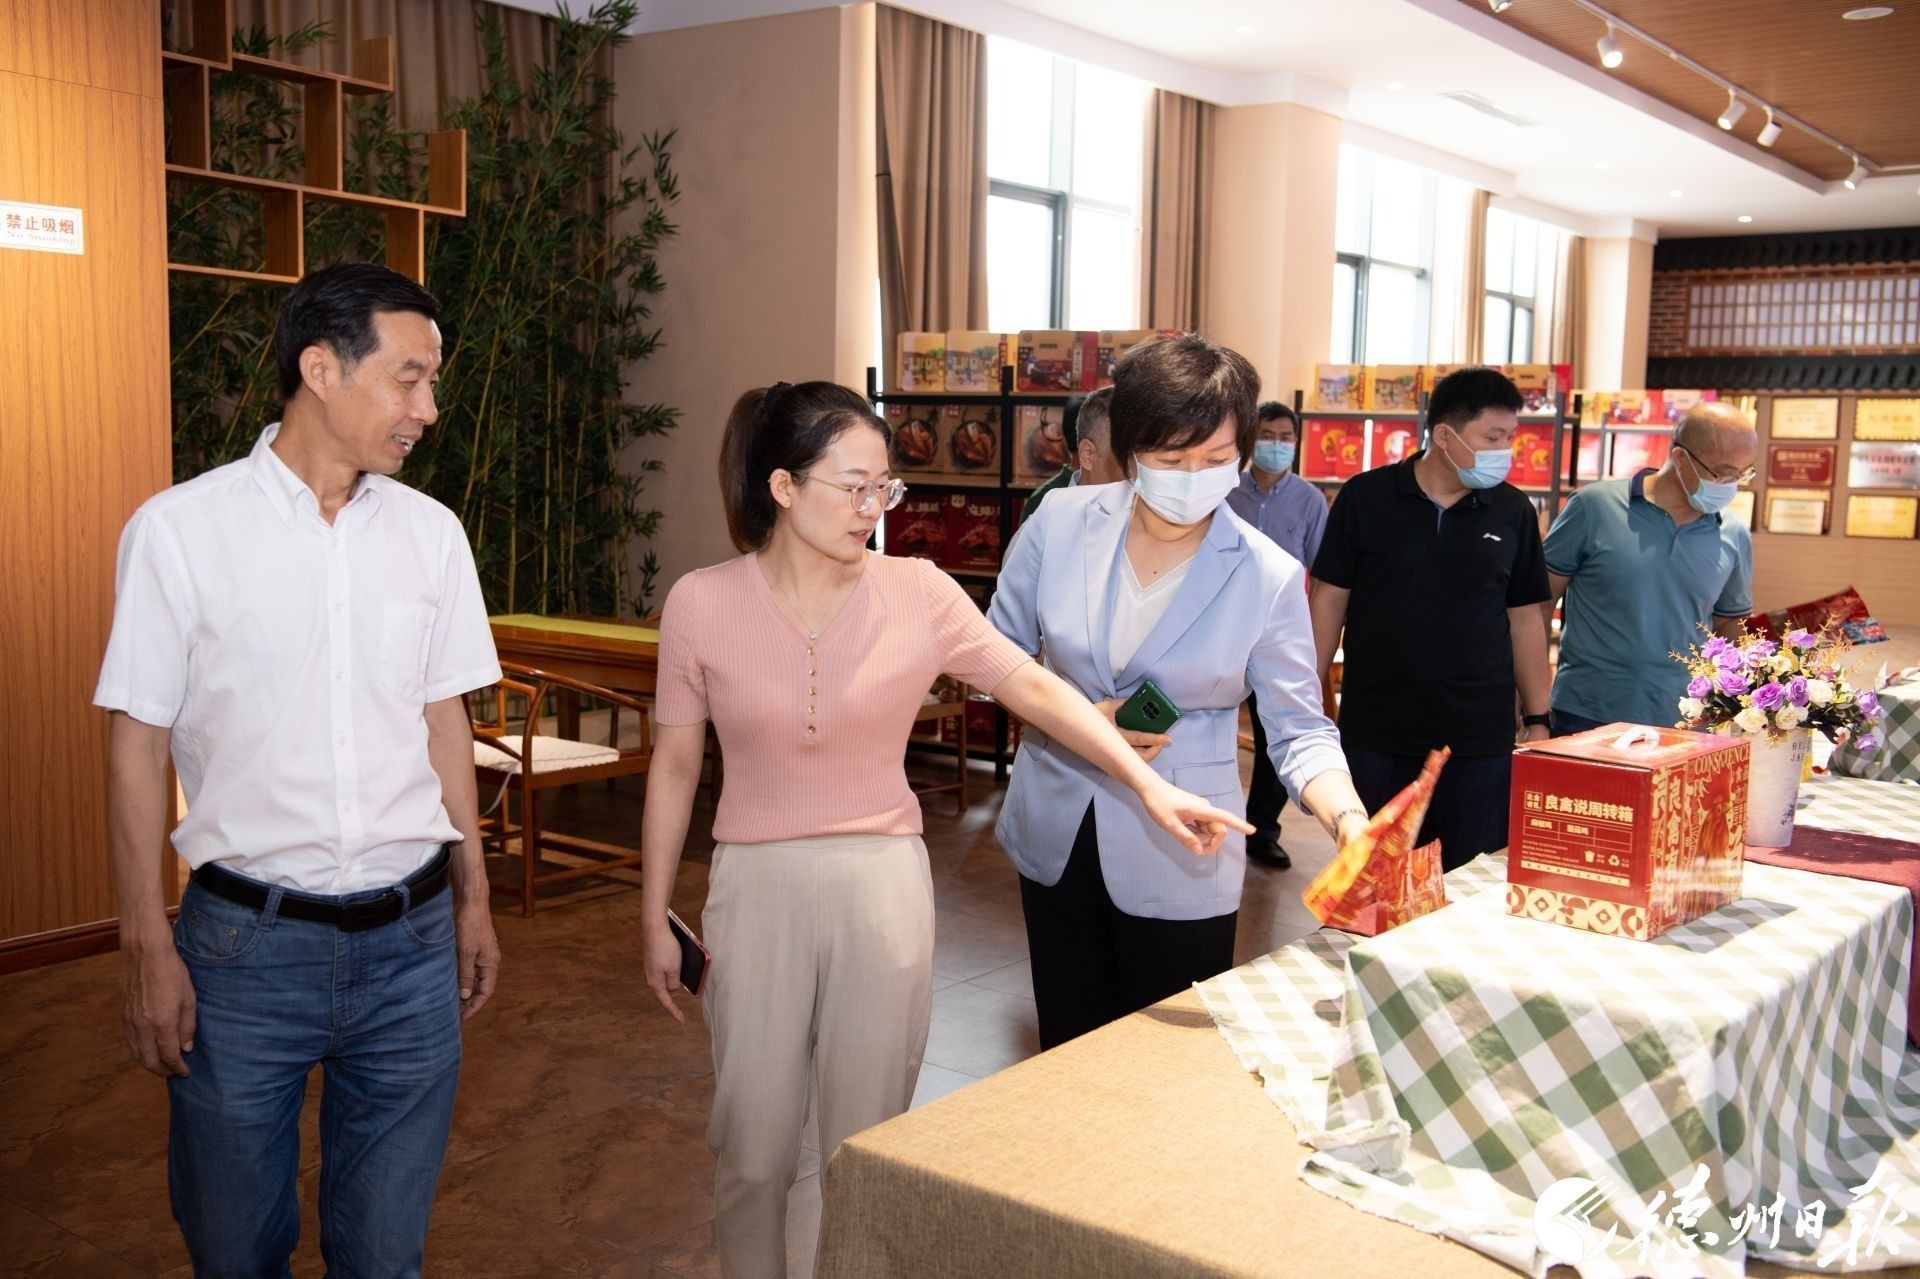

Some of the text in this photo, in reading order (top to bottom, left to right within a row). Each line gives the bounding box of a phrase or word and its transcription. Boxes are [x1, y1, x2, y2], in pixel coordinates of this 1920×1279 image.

[6, 213, 75, 234] 禁止吸烟
[1545, 795, 1634, 823] 良禽说周转箱
